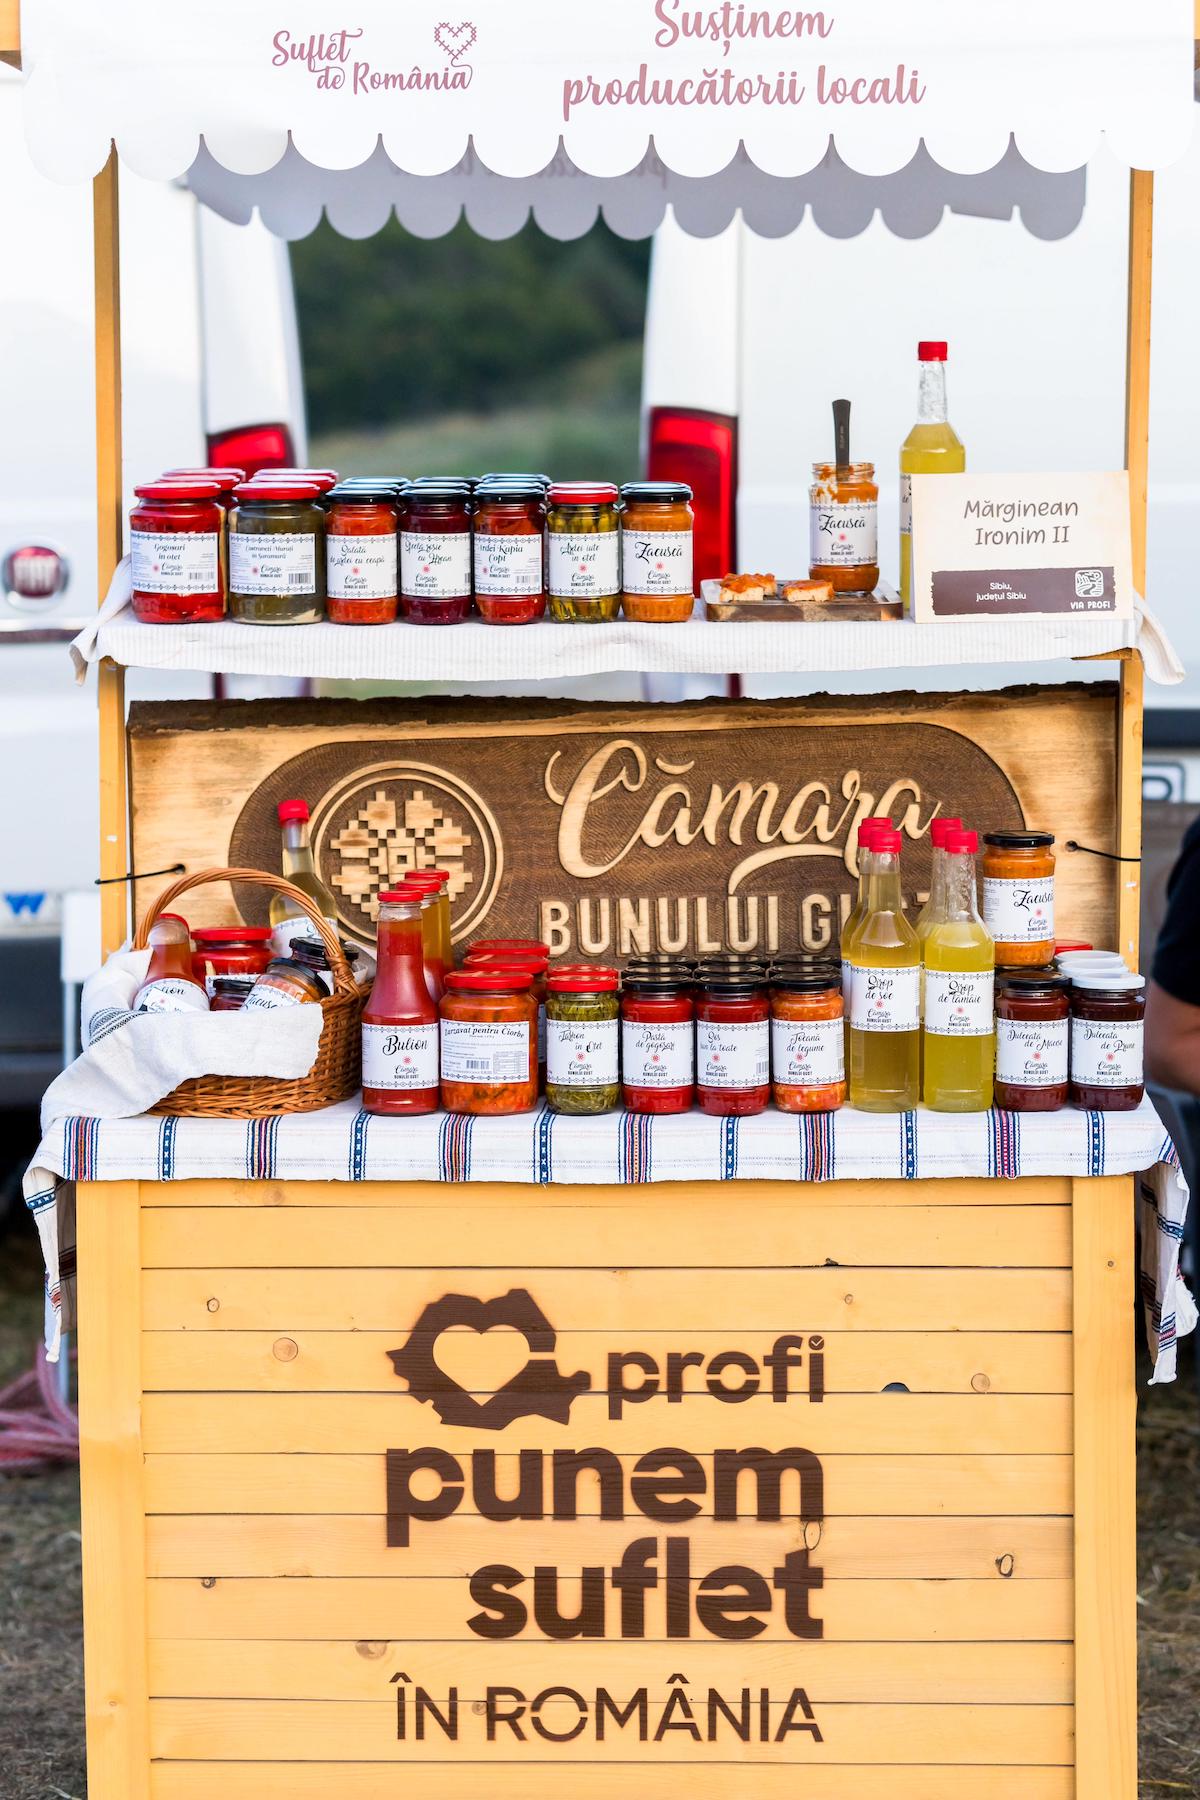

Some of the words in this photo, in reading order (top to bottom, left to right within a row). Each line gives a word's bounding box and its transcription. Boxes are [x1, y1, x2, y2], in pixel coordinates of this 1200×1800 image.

[272, 28, 363, 72] Suflet
[317, 66, 345, 89] de
[353, 62, 472, 95] România
[563, 64, 804, 121] producătorii
[816, 64, 926, 104] locali
[964, 499, 1079, 523] Mărginean
[975, 527, 1046, 546] Ironim
[1052, 525, 1071, 544] II
[1006, 591, 1027, 600] Sibiu
[1087, 601, 1111, 609] PROFI
[545, 739, 943, 895] Cămara
[540, 894, 779, 956] BUNULUI
[865, 991, 875, 999] de
[938, 994, 948, 1003] de
[382, 1035, 428, 1056] Bulion
[1024, 1040, 1034, 1048] de
[608, 1335, 825, 1420] profi
[386, 1446, 824, 1548] punem
[466, 1536, 824, 1639] suflet
[389, 1672, 458, 1741] ÎN
[486, 1673, 824, 1743] ROMÂNIA
